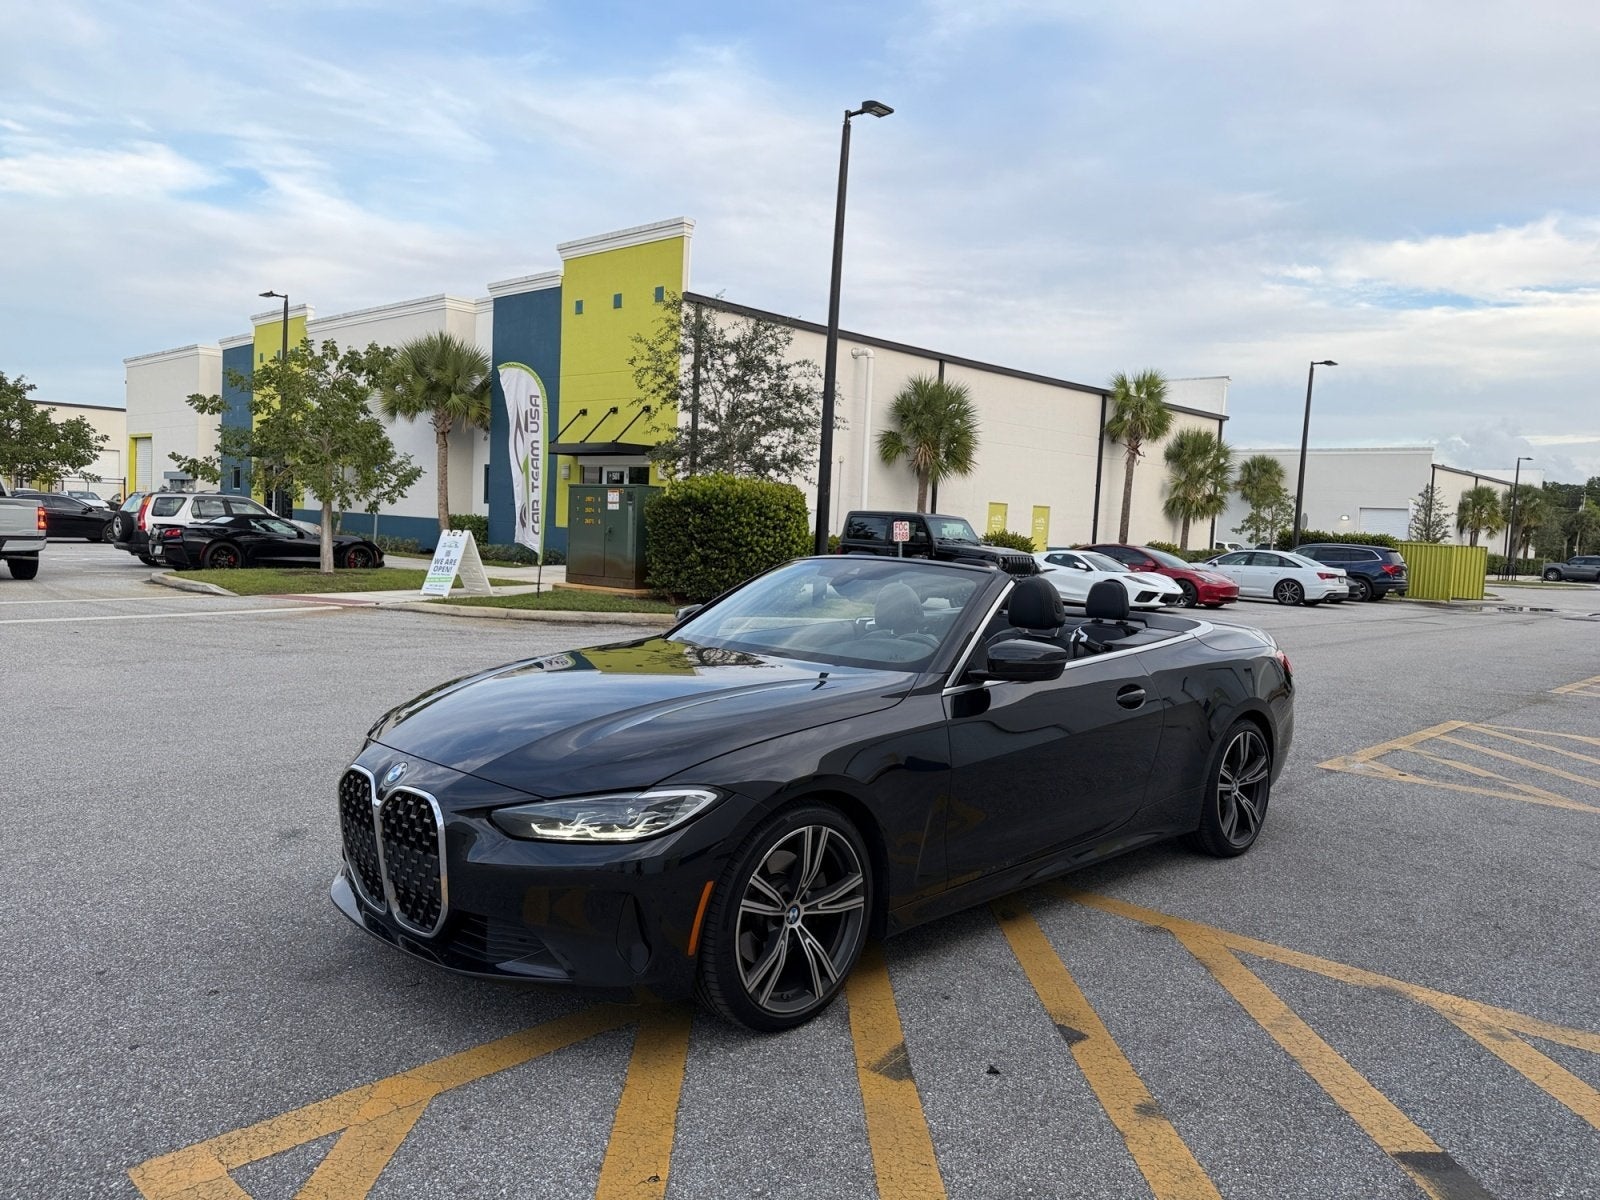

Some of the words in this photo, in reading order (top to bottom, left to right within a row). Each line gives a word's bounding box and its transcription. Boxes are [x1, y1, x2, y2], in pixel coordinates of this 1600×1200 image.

[529, 395, 540, 433] USA
[530, 439, 540, 493] TEAM
[531, 500, 540, 535] CAR
[894, 522, 908, 531] FDC
[444, 558, 457, 566] ARE
